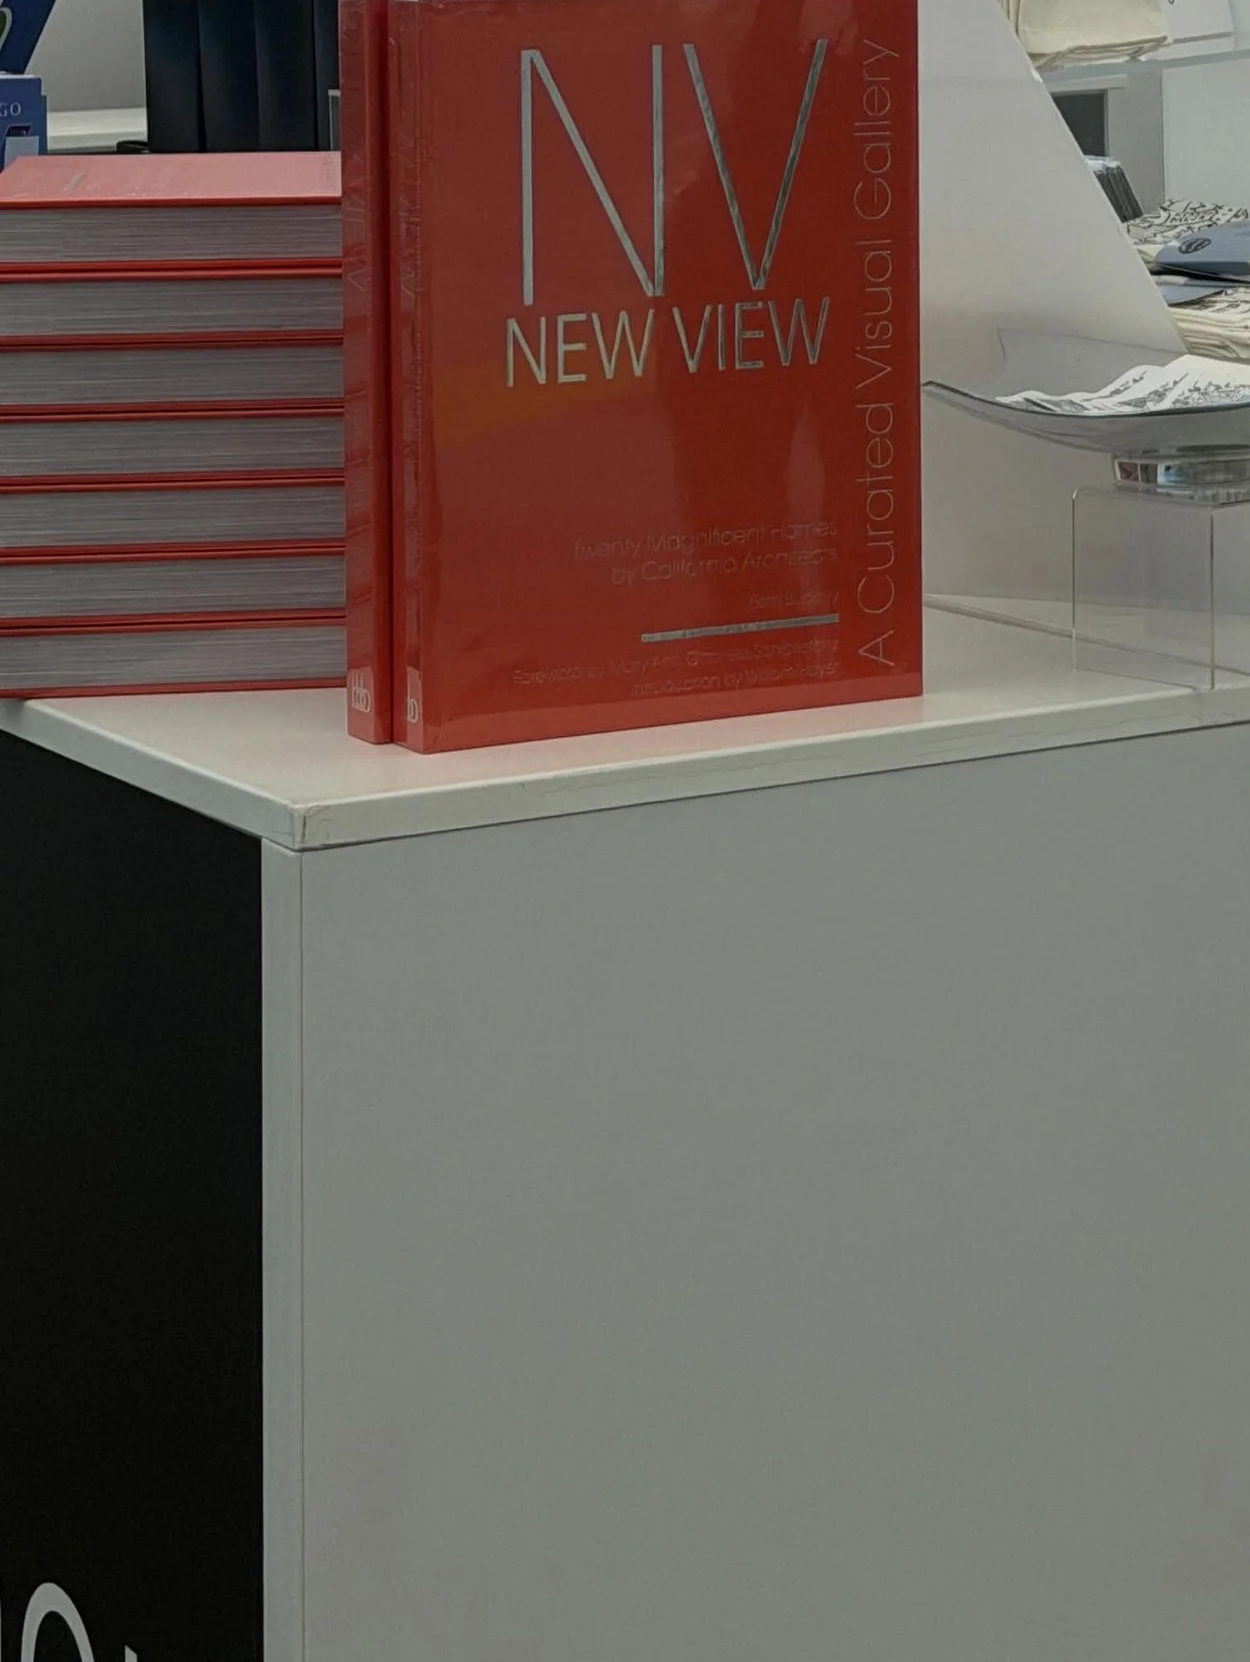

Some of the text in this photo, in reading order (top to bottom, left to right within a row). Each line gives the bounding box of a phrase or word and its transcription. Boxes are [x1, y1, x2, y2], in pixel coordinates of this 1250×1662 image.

[522, 39, 827, 307] NV
[505, 296, 830, 388] NEW VIEW
[854, 39, 900, 667] A Curated Visual Gallery
